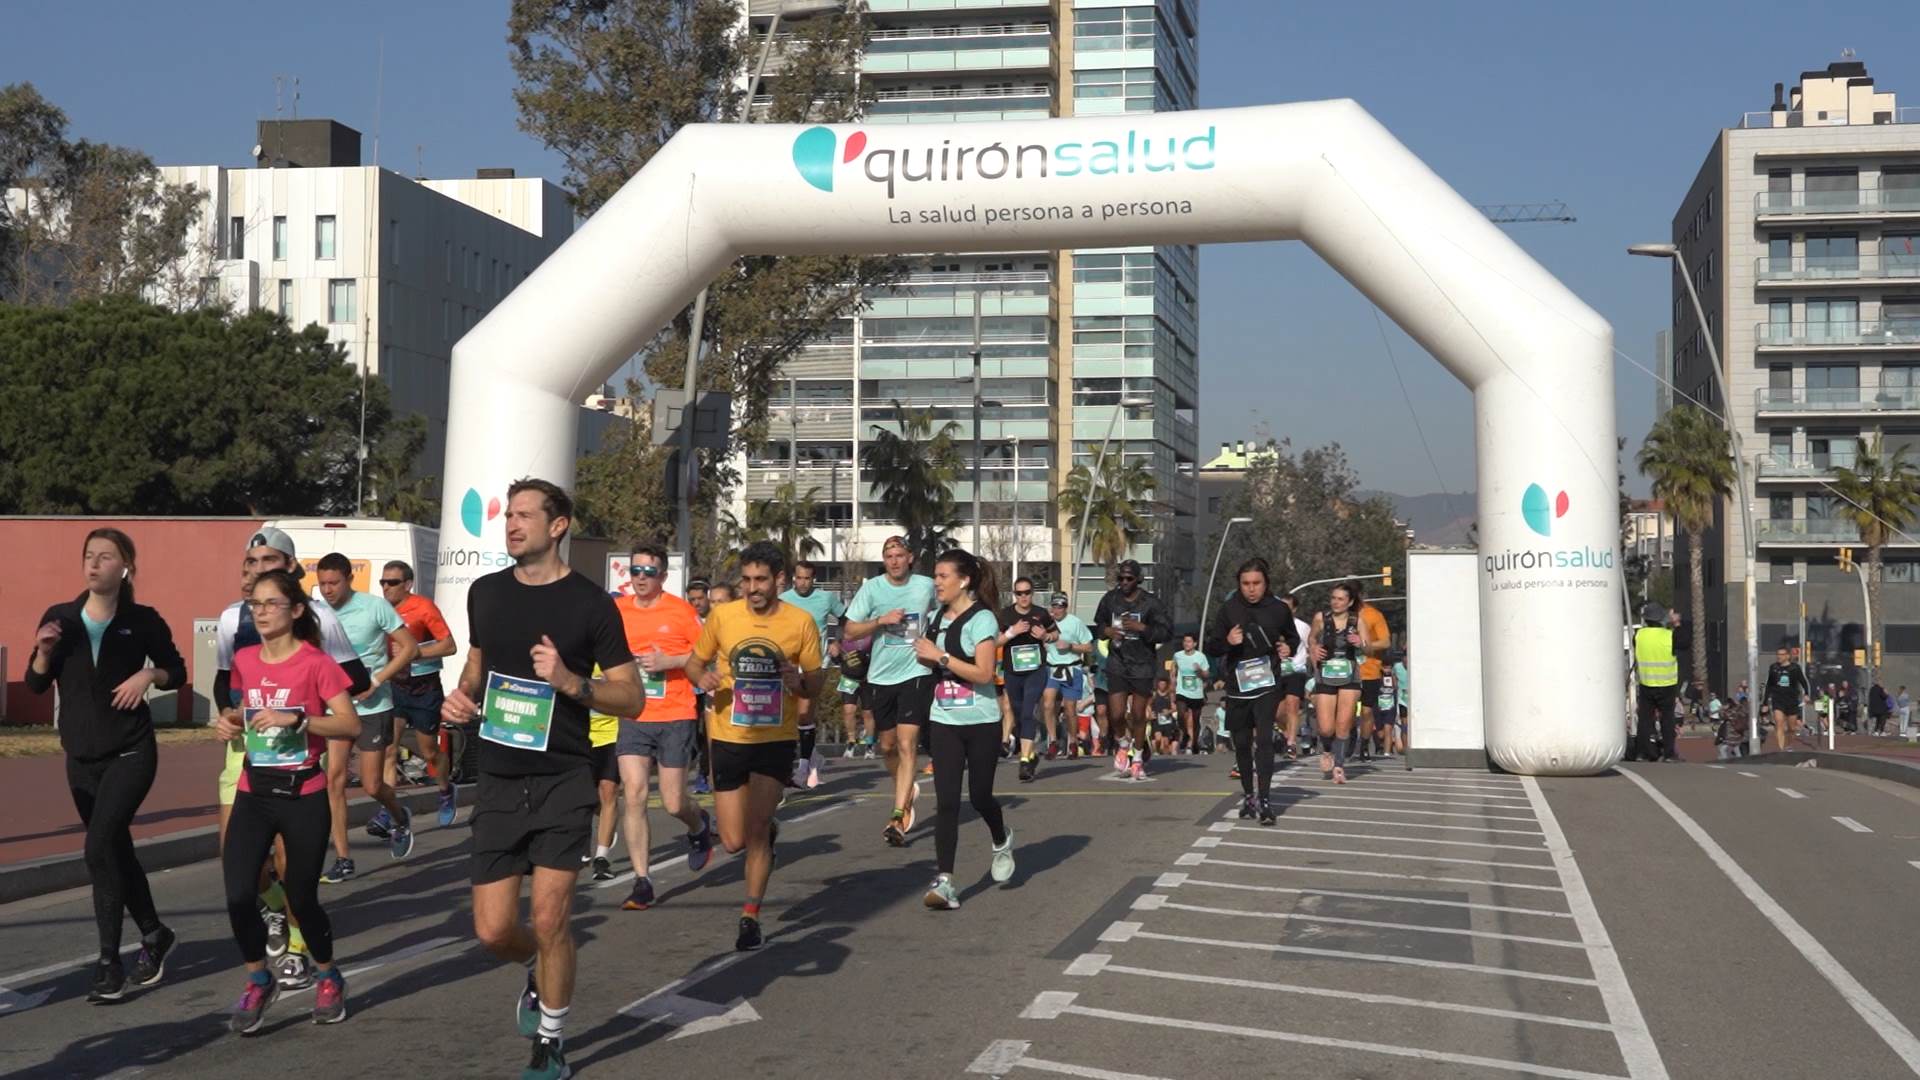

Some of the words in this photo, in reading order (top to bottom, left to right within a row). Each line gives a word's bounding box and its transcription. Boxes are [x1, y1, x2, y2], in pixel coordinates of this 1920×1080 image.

[864, 126, 1217, 199] quirónsalud
[889, 207, 912, 225] La
[920, 203, 977, 224] salud
[985, 202, 1074, 226] persona
[1082, 204, 1093, 219] a
[1102, 199, 1193, 221] persona
[438, 547, 514, 567] uirónsa
[1485, 546, 1613, 579] quirónsalud
[1500, 580, 1522, 589] salud
[1524, 580, 1564, 590] persona
[1567, 580, 1573, 588] a
[1576, 580, 1609, 589] persona
[738, 662, 777, 673] TRAIL
